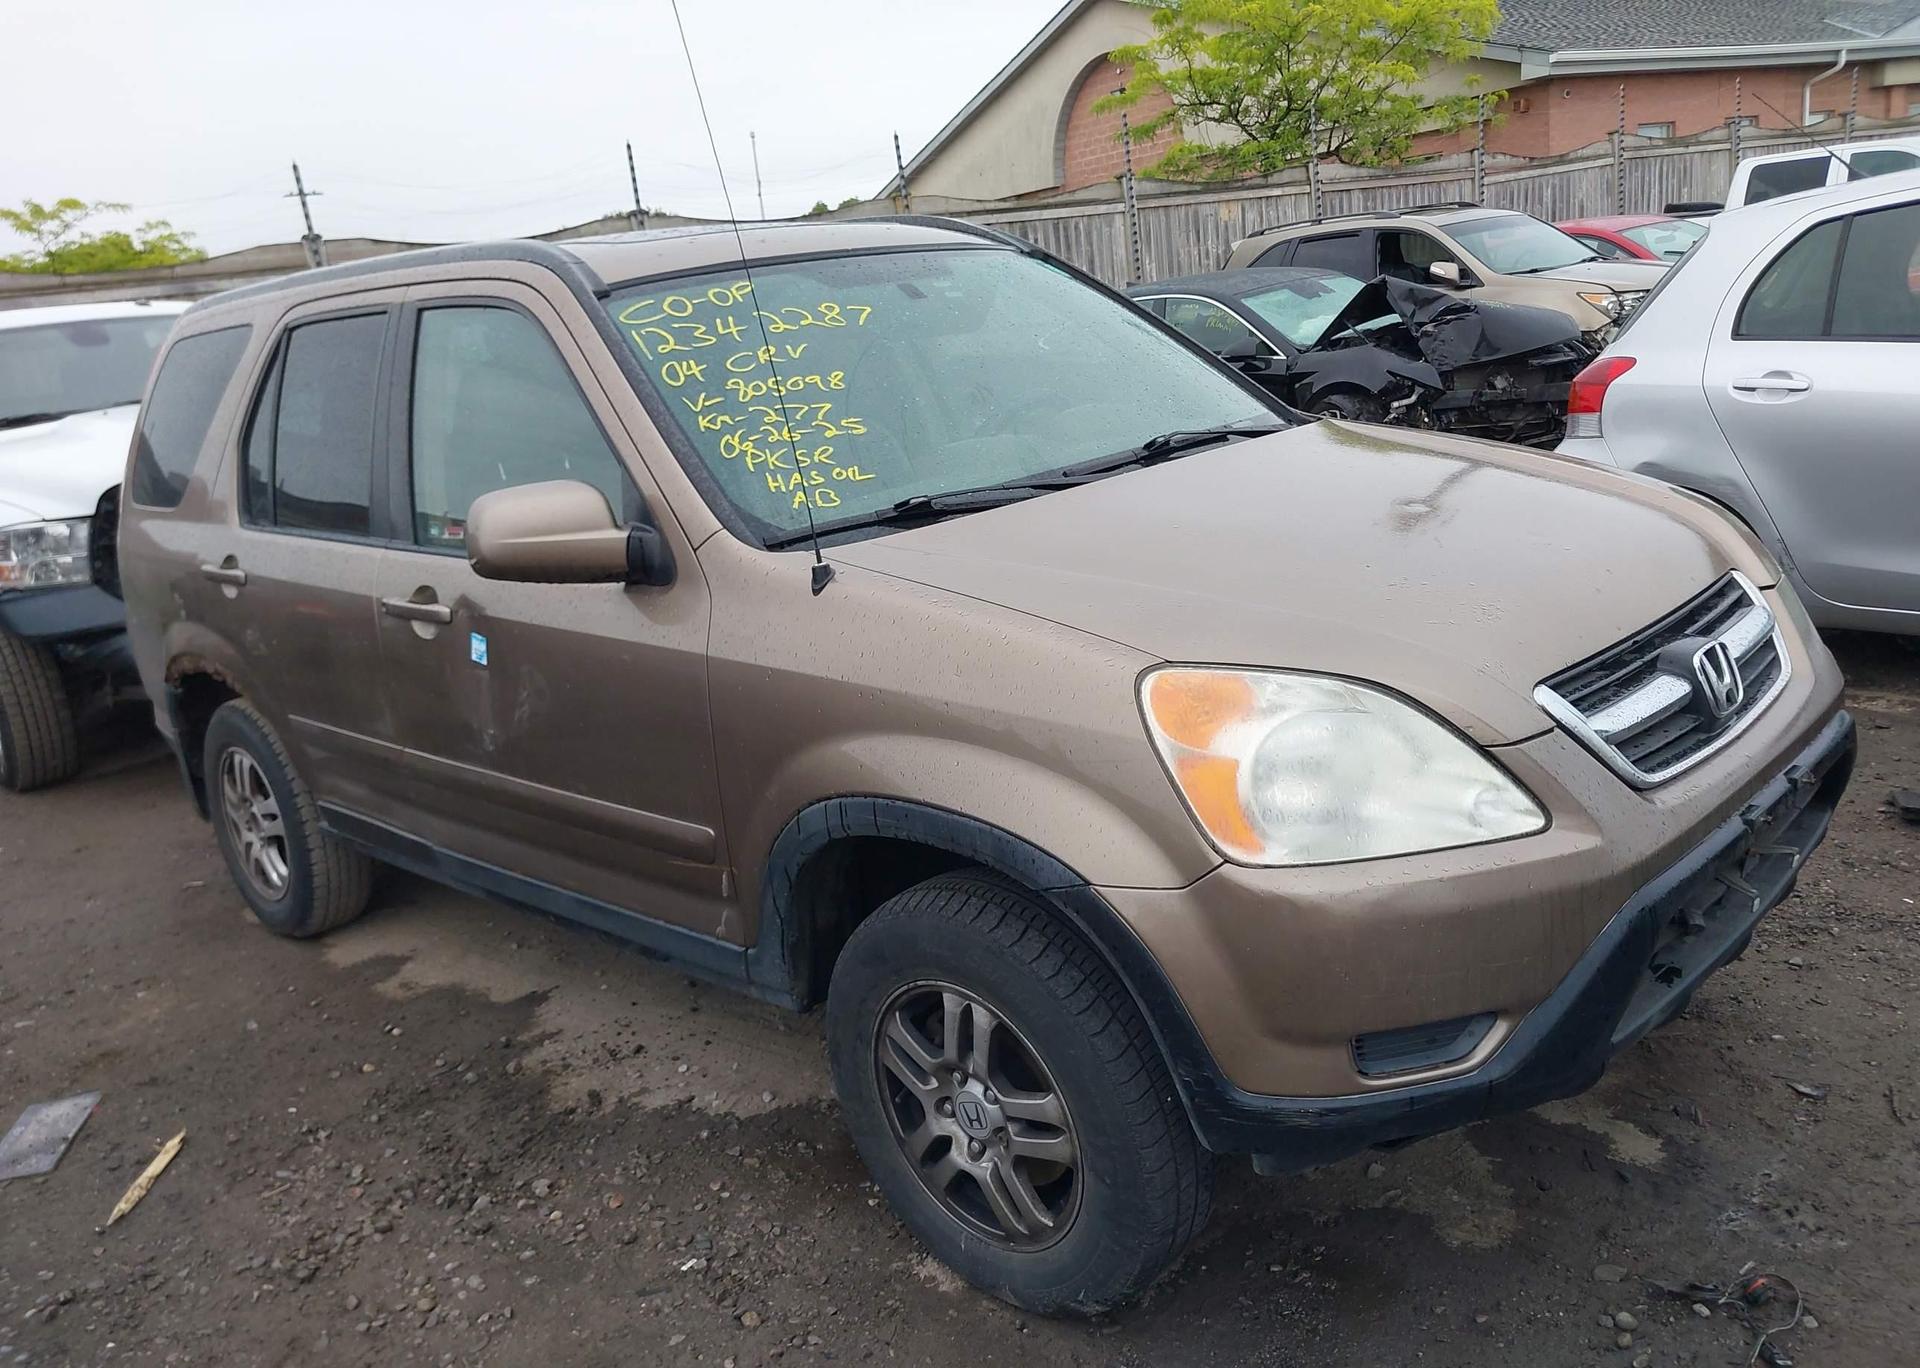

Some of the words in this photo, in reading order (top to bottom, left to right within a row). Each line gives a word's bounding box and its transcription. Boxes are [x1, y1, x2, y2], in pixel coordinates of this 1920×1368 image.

[619, 282, 754, 324] CO-OP
[661, 360, 707, 387] 04
[766, 470, 825, 493] HAS
